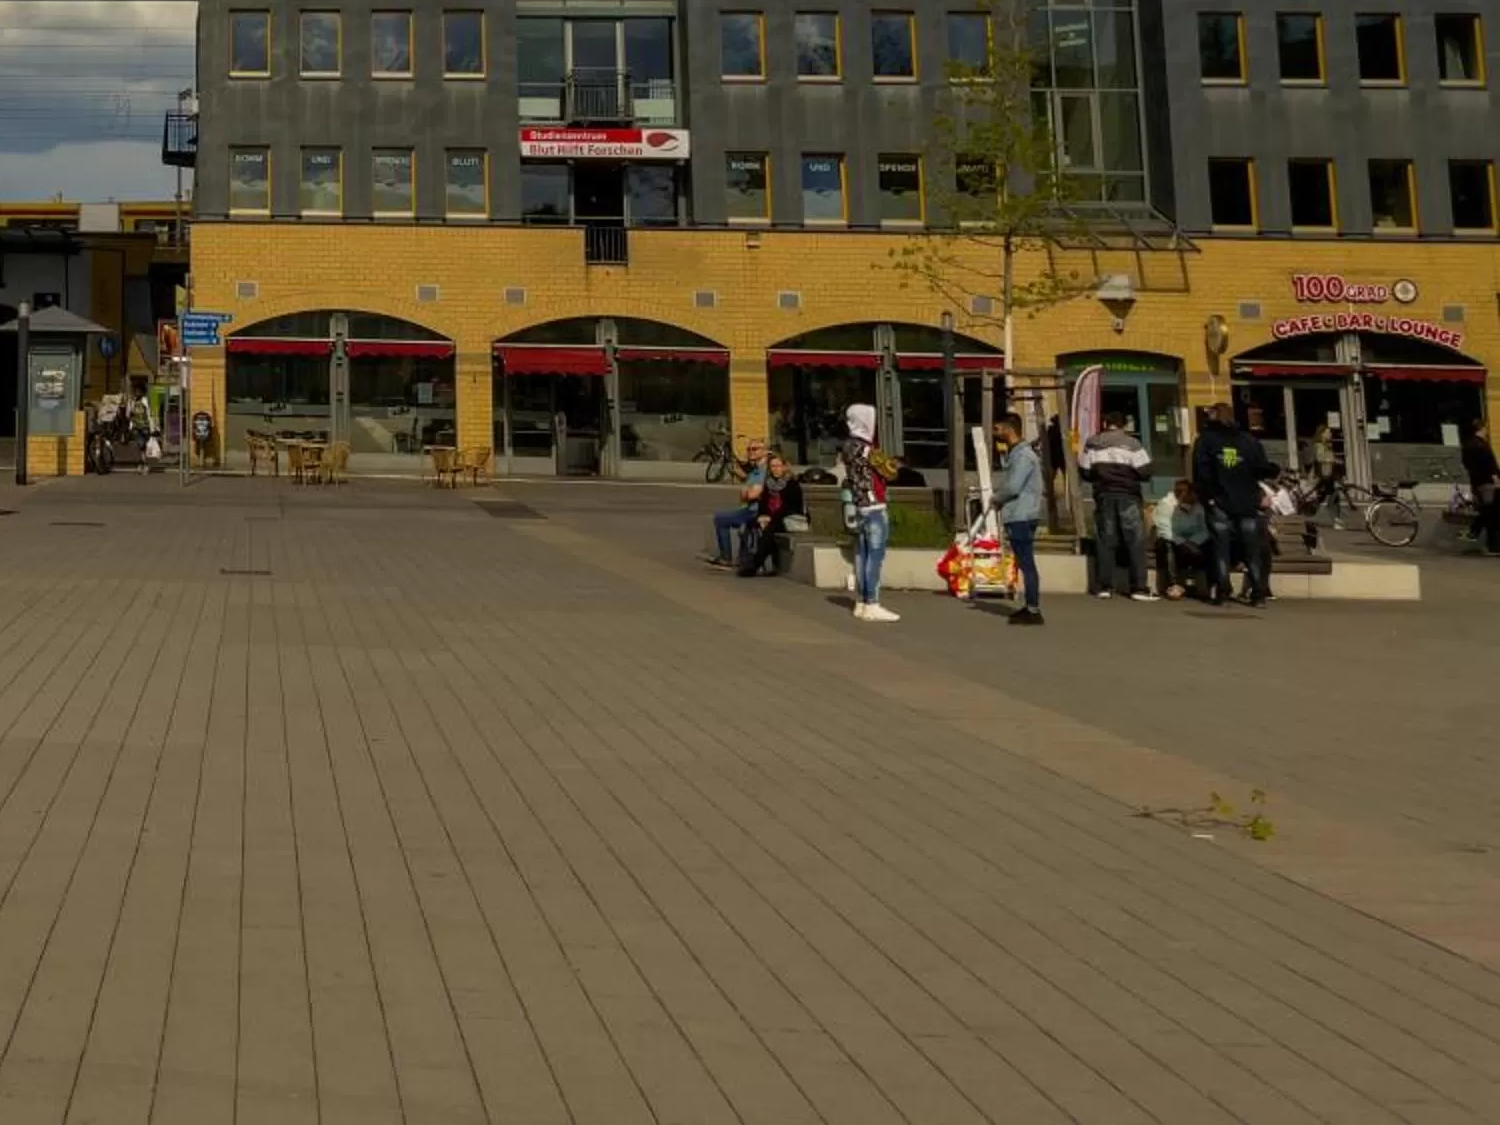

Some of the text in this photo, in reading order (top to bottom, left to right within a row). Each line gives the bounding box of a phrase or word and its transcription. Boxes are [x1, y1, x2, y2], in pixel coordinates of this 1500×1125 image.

[587, 144, 643, 156] Forschen
[1293, 274, 1388, 302] 100 GRAD
[1273, 311, 1463, 348] CAFE BAR LOUNGE
